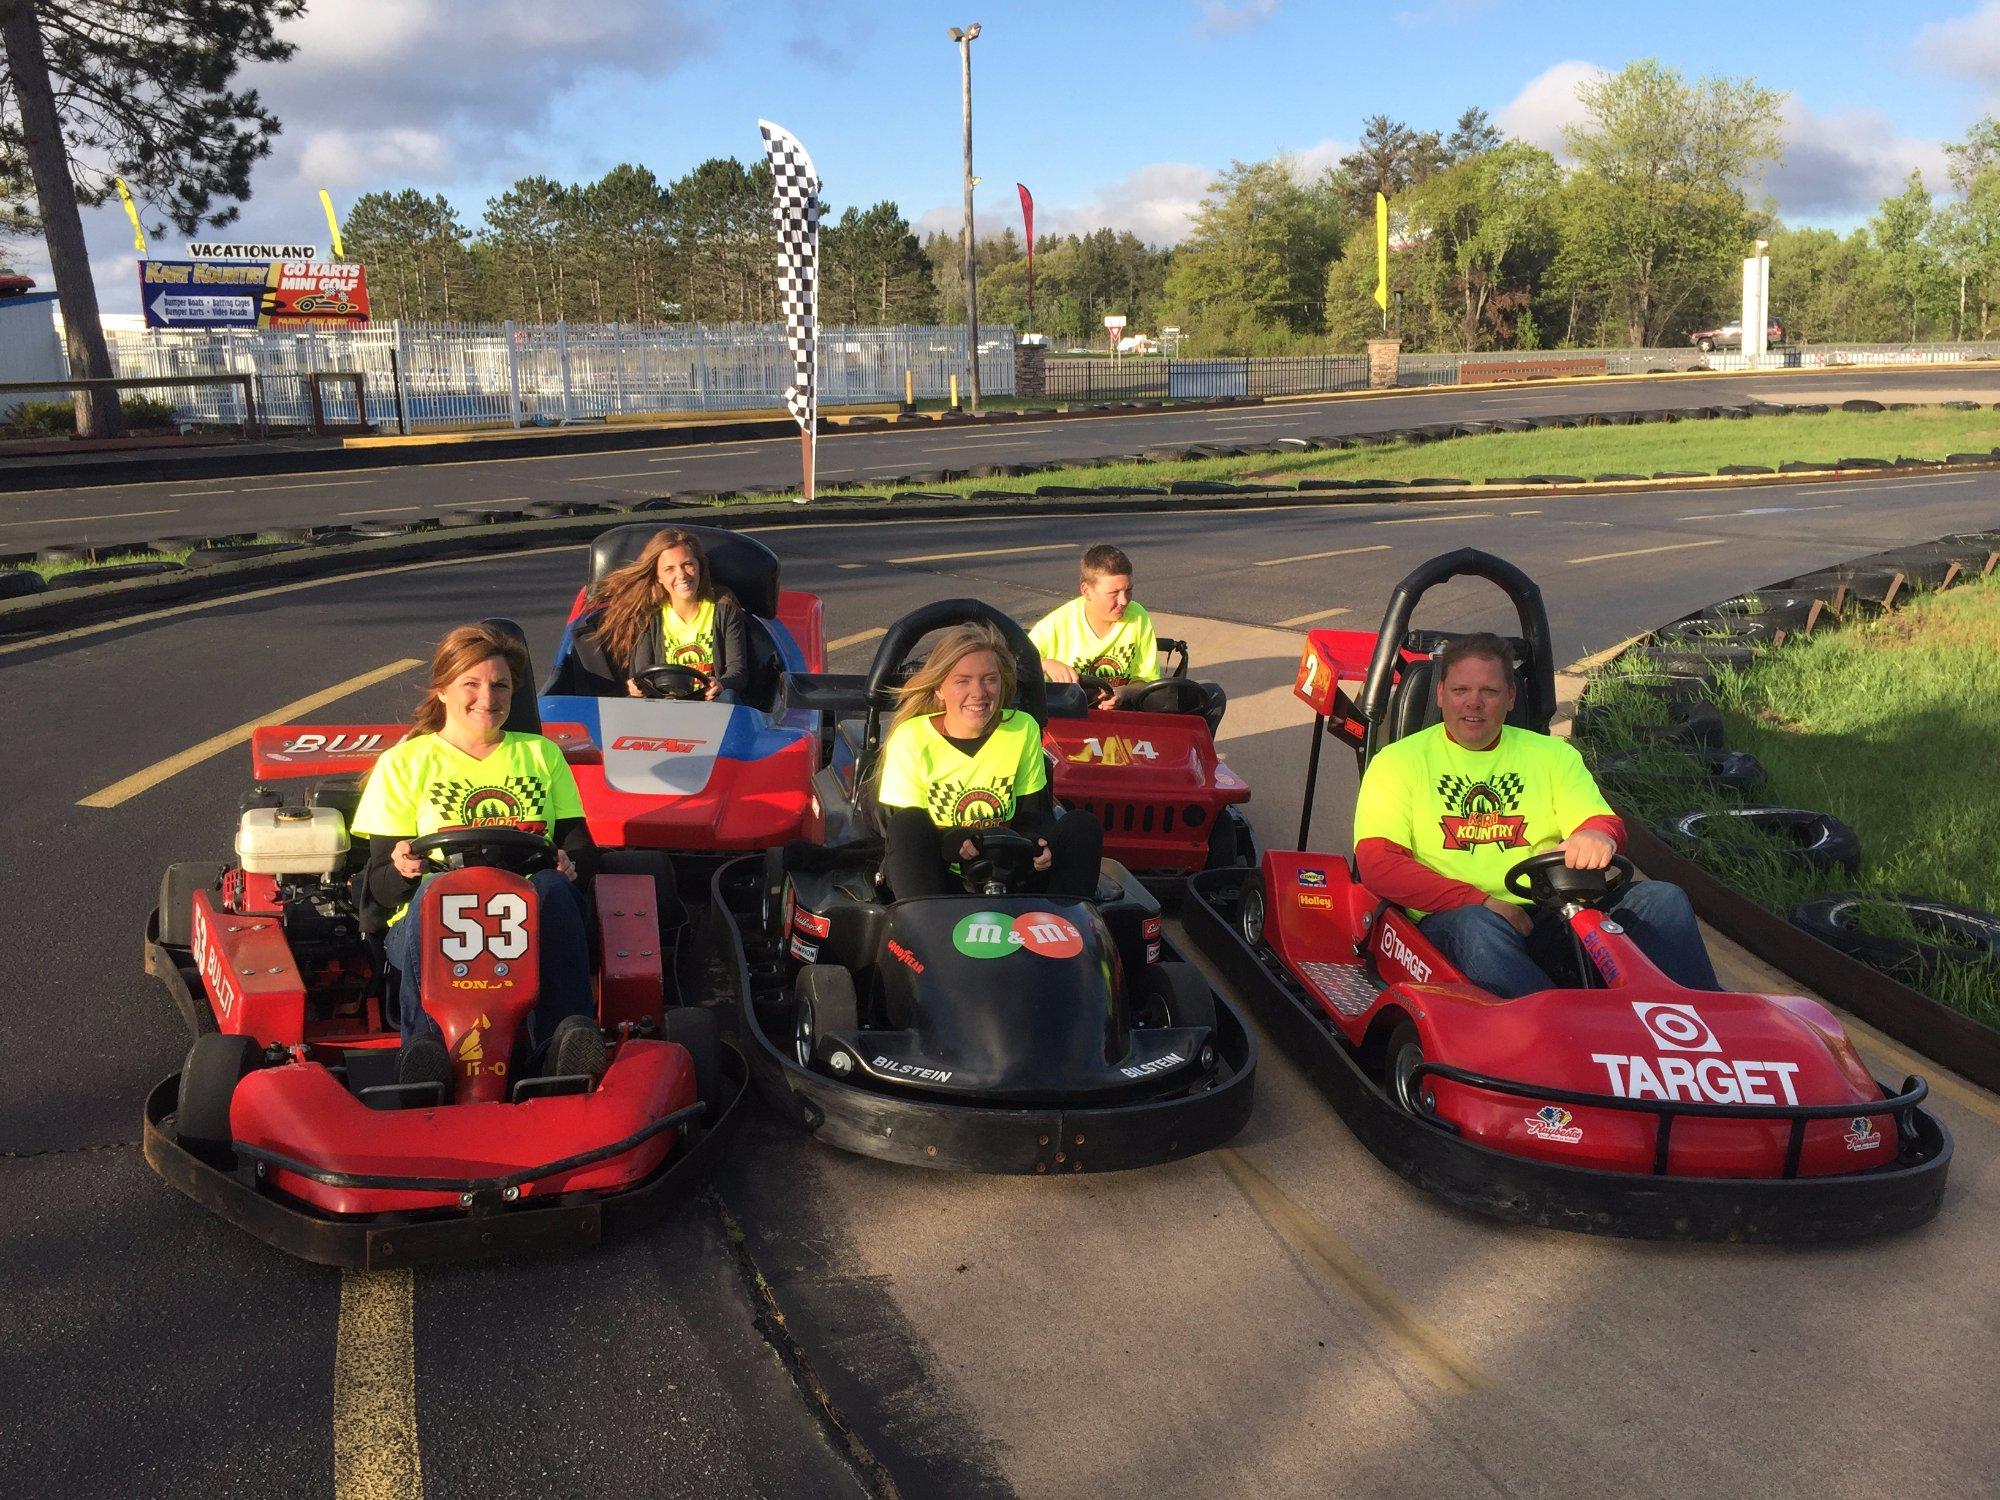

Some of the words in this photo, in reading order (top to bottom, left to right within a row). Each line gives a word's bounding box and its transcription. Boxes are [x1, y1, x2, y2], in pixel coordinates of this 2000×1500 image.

[191, 244, 314, 258] VACATIONLAND
[145, 262, 192, 283] KART
[193, 263, 268, 284] KOUNTRY
[283, 264, 306, 276] GO
[308, 264, 360, 277] KARTS
[281, 277, 317, 290] MINI
[319, 278, 358, 291] GOLF
[213, 299, 233, 308] Batting
[235, 299, 250, 308] Cages
[213, 308, 228, 316] Video
[229, 308, 247, 316] Arcade
[1301, 653, 1318, 698] 2
[1467, 810, 1500, 827] KART
[1456, 824, 1515, 840] KOUNTRY
[1300, 895, 1331, 908] Holley
[441, 893, 529, 961] 53
[888, 939, 924, 974] GOODYEAR
[1394, 937, 1432, 983] TARGET
[872, 1055, 952, 1083] BILSTEIN
[1120, 1053, 1185, 1078] BILSTEIN
[1591, 1053, 1799, 1106] TARGET
